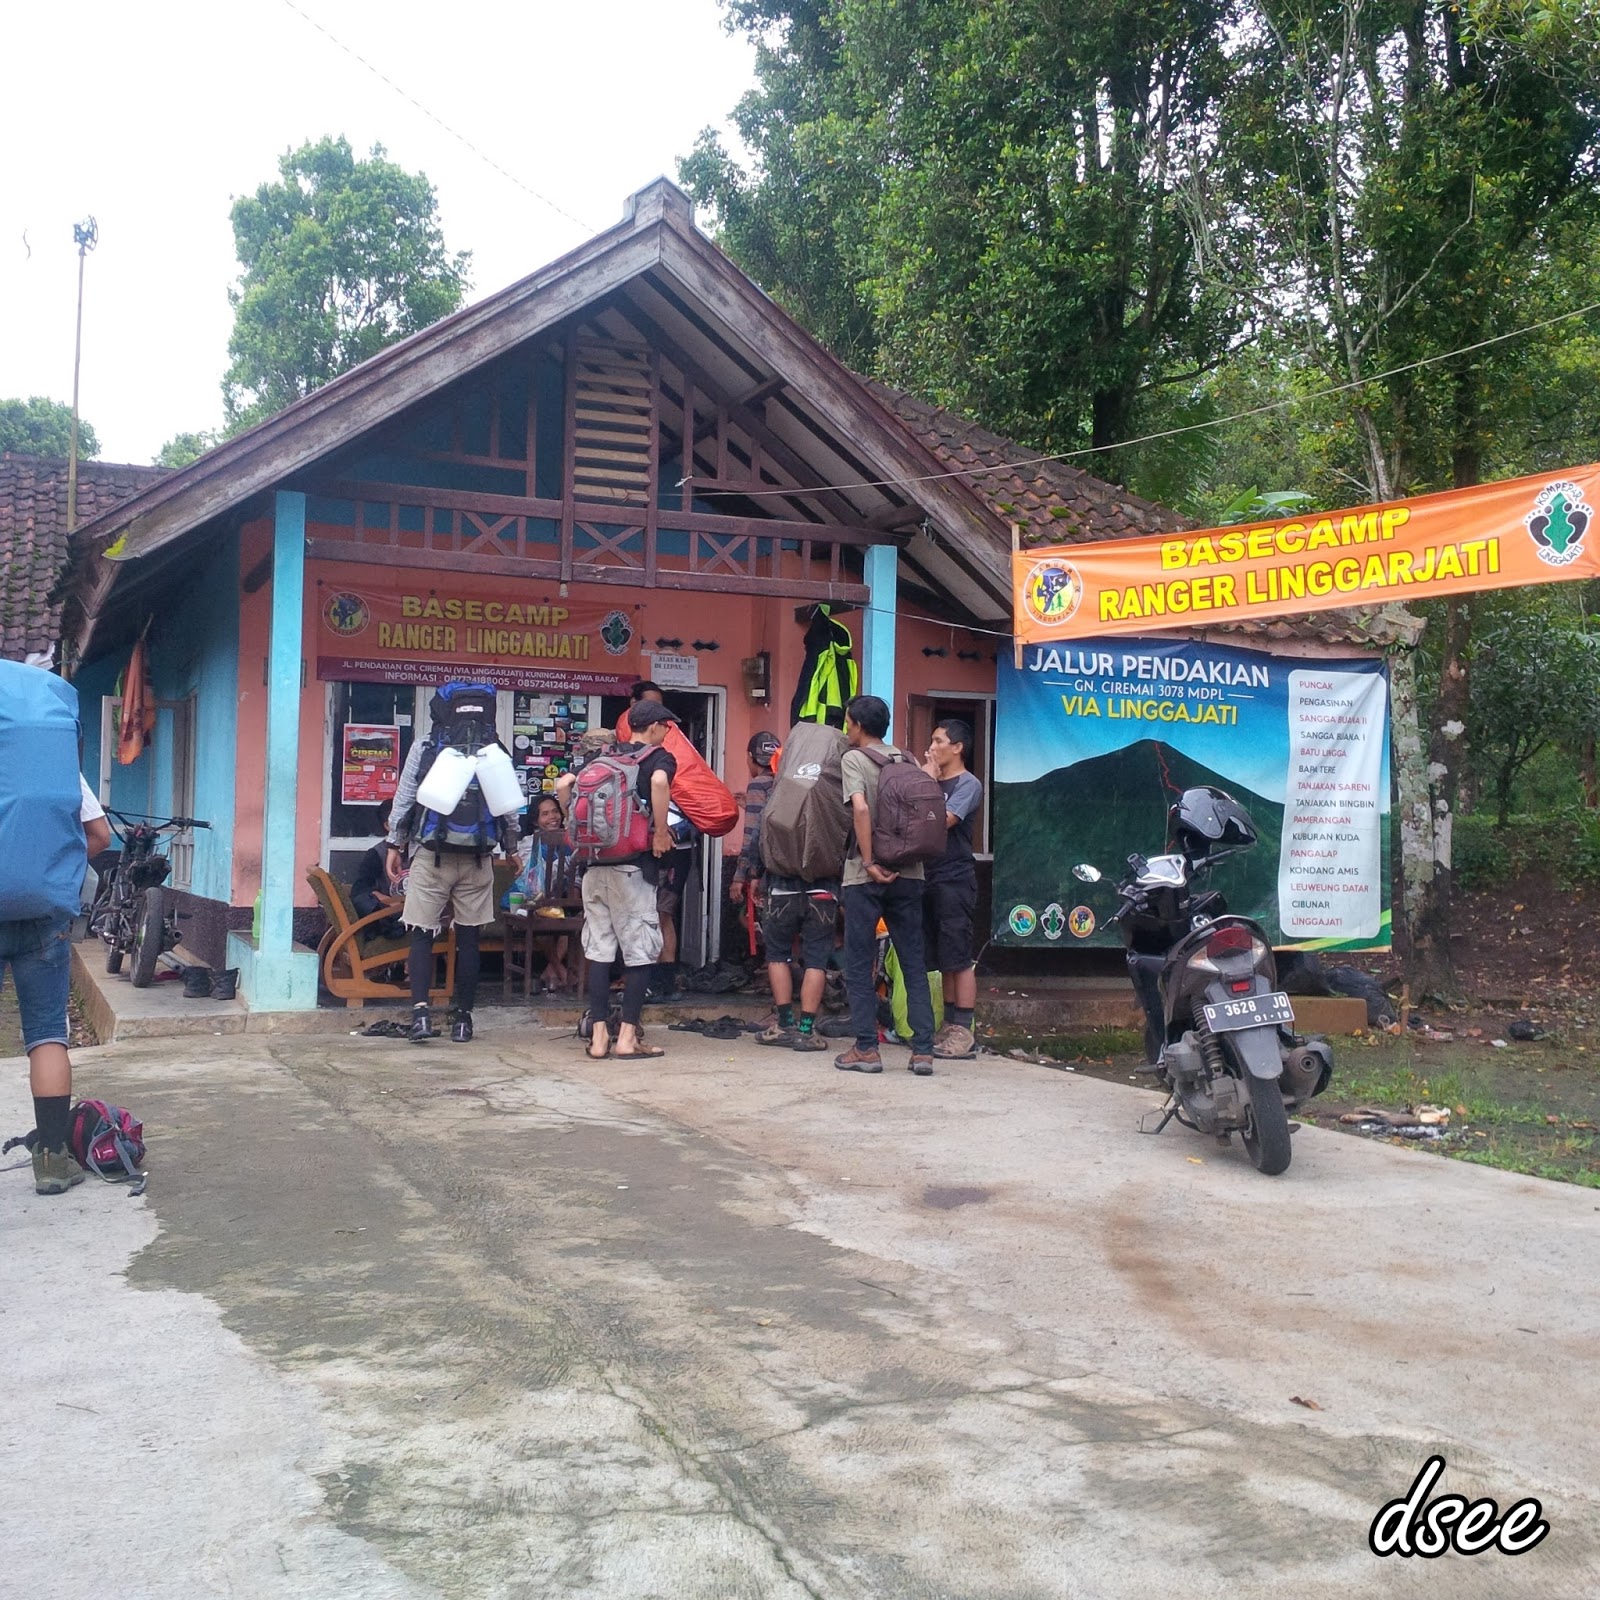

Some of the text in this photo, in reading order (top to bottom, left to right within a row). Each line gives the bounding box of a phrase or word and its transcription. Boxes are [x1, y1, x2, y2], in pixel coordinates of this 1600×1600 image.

[1537, 482, 1582, 506] KOMPEPAR
[1161, 506, 1411, 570] BASECAMP
[1099, 537, 1500, 622] RANGER LINGGARJATI
[402, 595, 569, 627] BASECAMP
[378, 622, 589, 660] RANGER LINGGARJATI
[354, 662, 402, 670] PENDAKIAN
[420, 665, 452, 673] CIREMAI
[453, 666, 470, 675] (VIA
[526, 671, 566, 679] KUNINGAN
[572, 674, 593, 682] JAWA
[595, 675, 618, 683] BARAT
[1029, 648, 1270, 688] JALUR PENDAKIAN
[384, 672, 437, 682] INFORMASI
[517, 678, 580, 690] 085724124649
[1300, 681, 1333, 690] PUNCAK
[1074, 679, 1225, 700] GN. CIREMAI 3078 MDPL
[1300, 697, 1353, 707] PENGASINAN
[1062, 695, 1237, 725] VIA LINGGAJATI
[1300, 715, 1336, 723] SANGGA
[1300, 731, 1335, 740] SANGGA
[1300, 748, 1320, 756] BATU
[1320, 766, 1336, 774] TERE
[1298, 782, 1370, 791] TANJAKAN SARENI
[1296, 799, 1374, 808] TANJAKAN BINGBIN
[1294, 816, 1351, 824] PAMERANGAN
[1292, 833, 1360, 841] KUBURAN KUDA
[1290, 850, 1338, 858] PANGALAP
[1290, 867, 1359, 875] KONDANG AMIS
[1291, 884, 1369, 893] LEUWEUNG DATAR
[1292, 900, 1330, 909] CIBUNAR
[1292, 918, 1342, 926] LINGGAJATI
[1207, 1007, 1216, 1019] D
[1224, 1000, 1256, 1016] 3628
